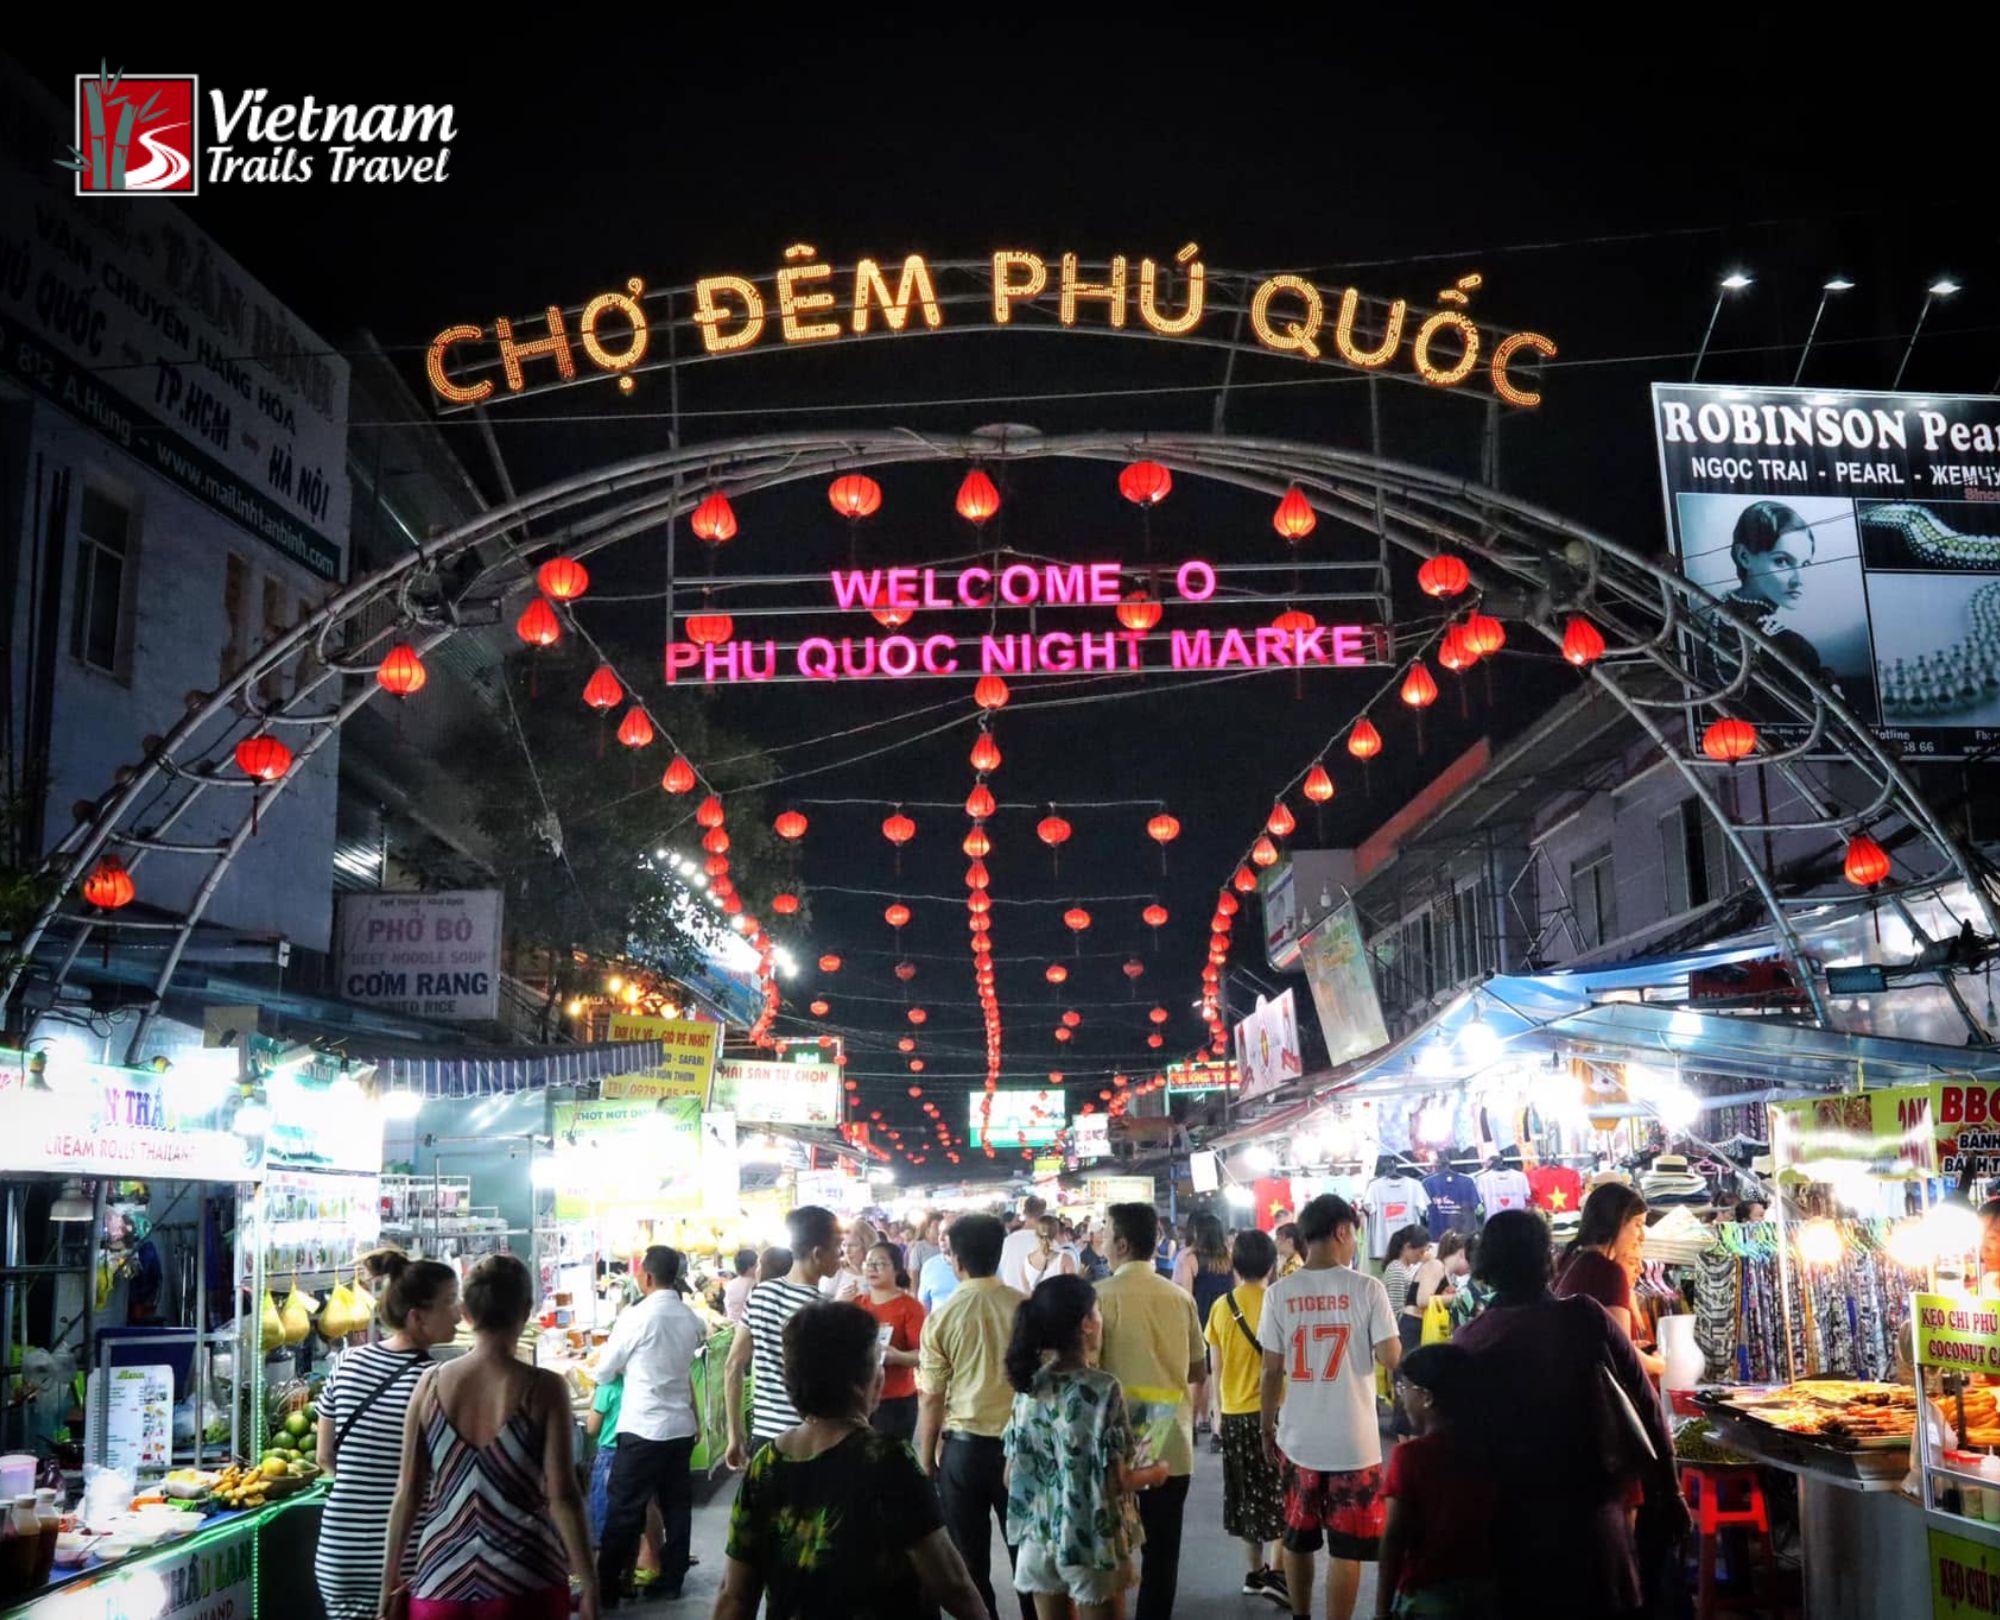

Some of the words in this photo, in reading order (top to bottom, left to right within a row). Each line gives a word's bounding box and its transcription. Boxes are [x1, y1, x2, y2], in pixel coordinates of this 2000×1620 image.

[426, 276, 648, 404] CHỢ
[693, 243, 943, 355] ĐÊM
[993, 241, 1205, 336] PHÚ
[1249, 271, 1558, 406] QUỐC
[154, 356, 231, 451] TP.HCM
[267, 443, 293, 498] HÀ
[297, 465, 330, 523] NỘI
[1661, 401, 1907, 450] ROBINSON
[1692, 457, 1753, 483] NGỌC
[1758, 459, 1808, 481] TRAI
[1835, 462, 1904, 484] PEARL
[156, 440, 336, 578] www.mailinhtanbinh.com
[831, 563, 1122, 611] WELCOME
[665, 640, 777, 686] PHU
[797, 634, 959, 682] QUOC
[981, 630, 1148, 675] NIGHT
[368, 908, 426, 943] PHỞ
[391, 952, 445, 966] NOODLE
[450, 951, 488, 966] SOUP
[347, 970, 408, 997] CƠM
[416, 972, 489, 996] RANG
[424, 1000, 457, 1014] RICE
[1943, 1151, 1990, 1173] BÁH
[1286, 1295, 1350, 1313] TIGERS
[1921, 1308, 1945, 1333] KẸO
[1291, 1323, 1351, 1382] 17
[1928, 1339, 1985, 1366] COCONUT
